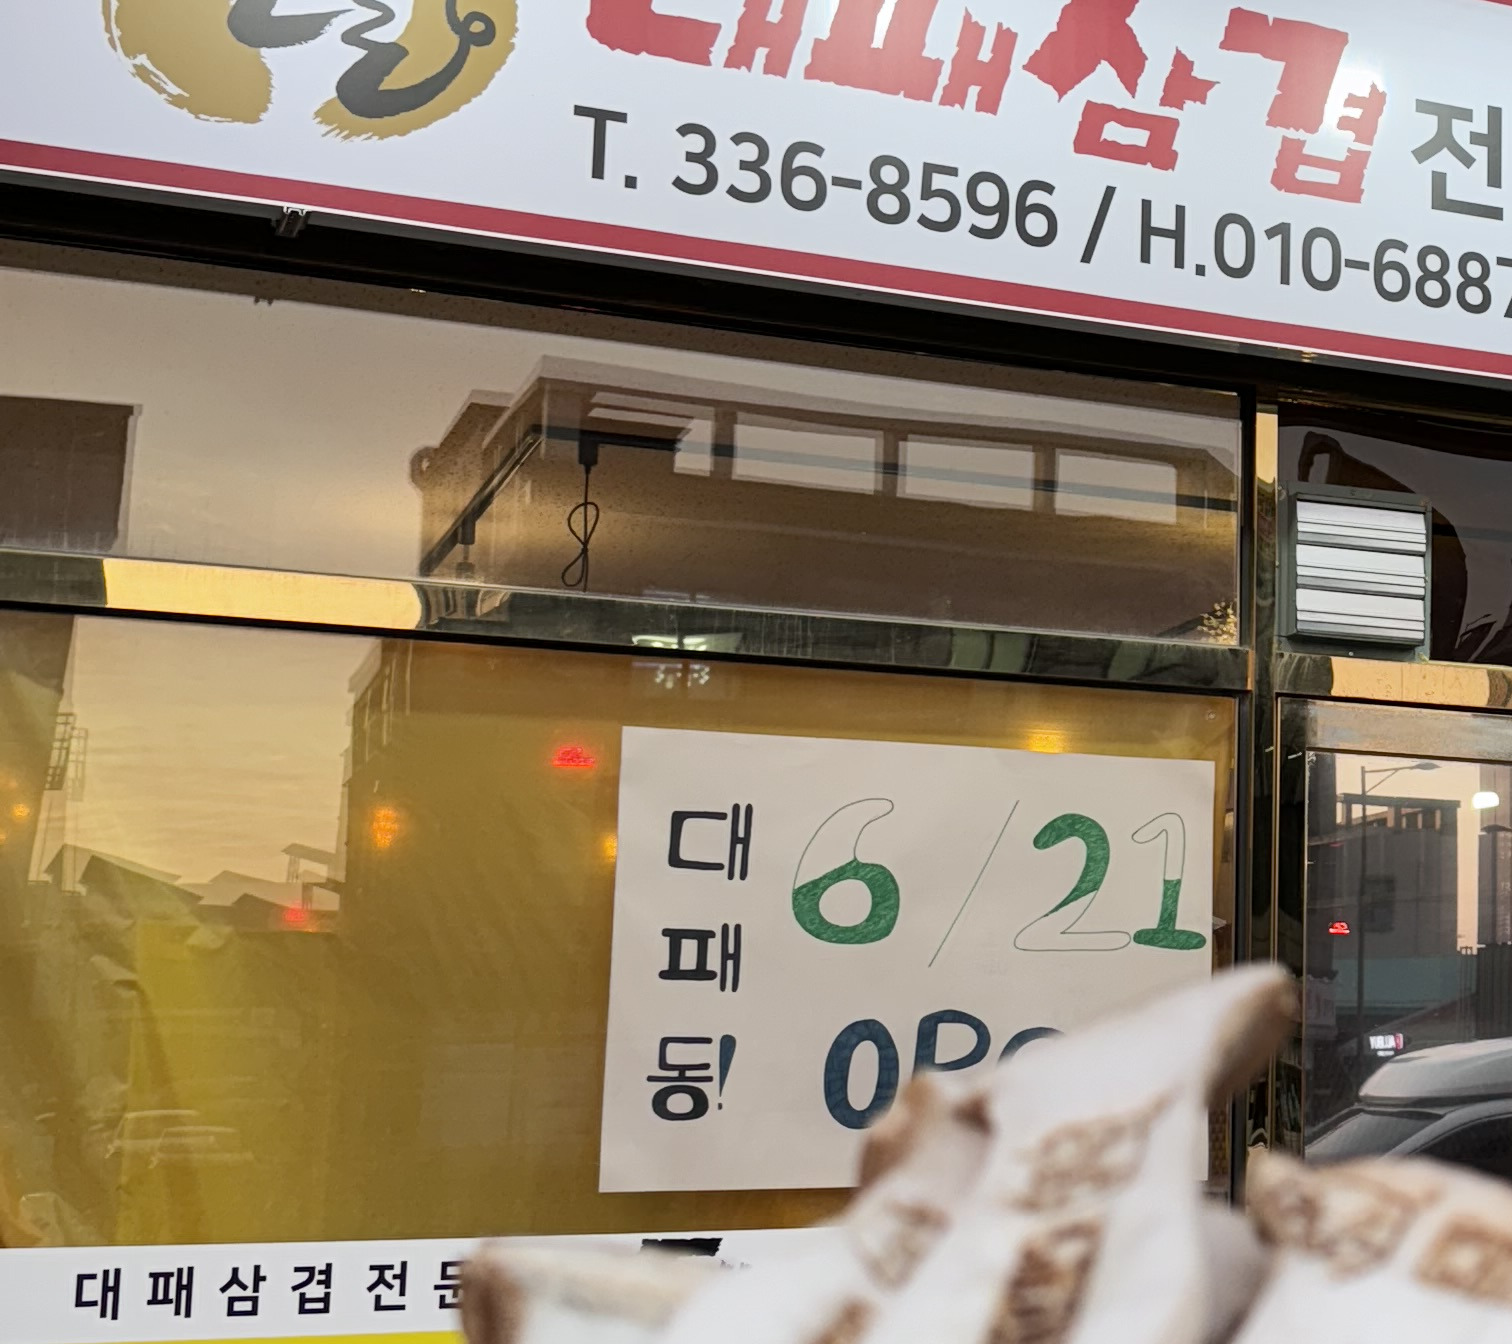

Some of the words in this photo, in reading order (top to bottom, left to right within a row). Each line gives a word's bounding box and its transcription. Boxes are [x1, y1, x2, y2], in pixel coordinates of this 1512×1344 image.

[573, 104, 637, 189] T.
[671, 122, 1058, 247] 336-8596
[792, 797, 1206, 967] 6/21
